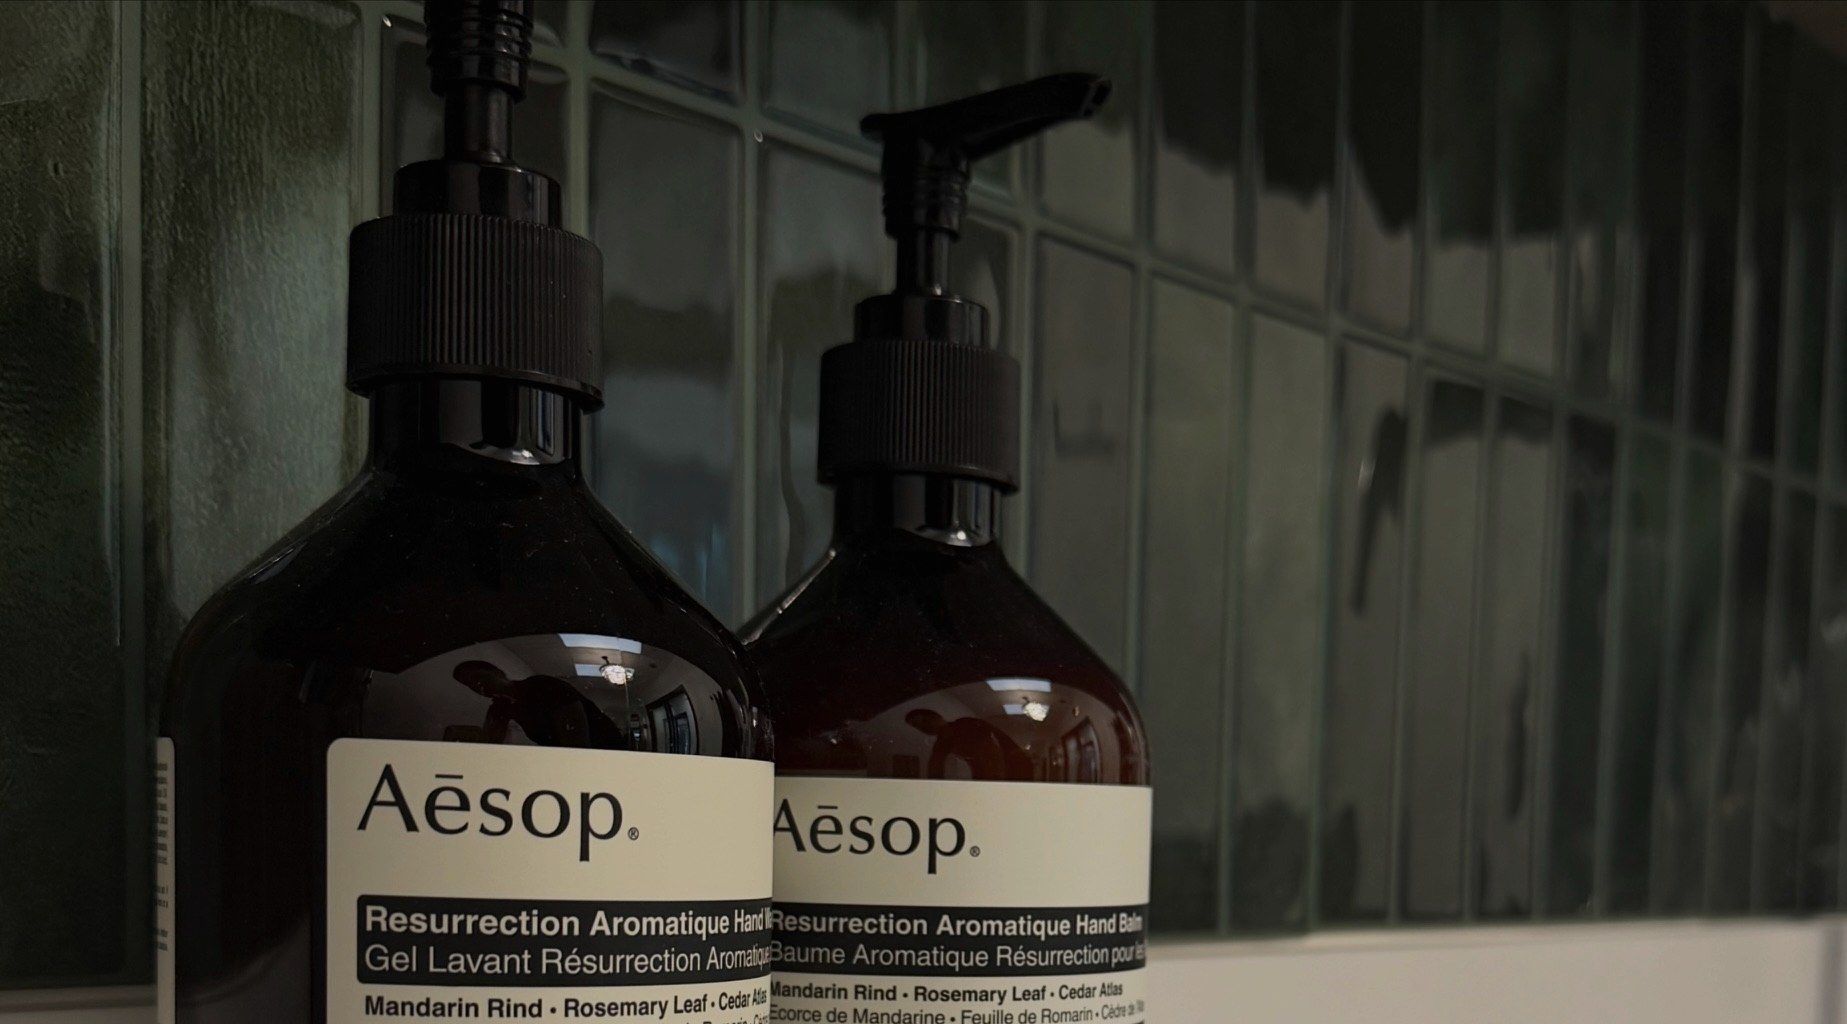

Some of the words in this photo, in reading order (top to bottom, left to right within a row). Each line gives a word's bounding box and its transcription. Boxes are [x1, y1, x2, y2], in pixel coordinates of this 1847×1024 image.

[365, 905, 579, 937] Resurrection
[590, 911, 730, 940] Aromatique
[734, 908, 763, 932] Hand
[772, 911, 927, 936] Resurrection
[936, 913, 1070, 940] Aromatique
[1076, 914, 1116, 935] Hand
[365, 945, 417, 972] Gel
[429, 948, 531, 974] Lavant
[541, 948, 700, 974] Résurrection
[769, 941, 845, 964] Baume
[853, 944, 988, 971] Aromatique
[997, 945, 1109, 967] Résurrection
[1111, 945, 1134, 968] pour
[365, 996, 479, 1017] Mandarin
[488, 999, 542, 1017] Rind
[564, 999, 667, 1020] Rosemary
[674, 994, 707, 1014] Leaf
[719, 991, 750, 1010] Cedar
[854, 984, 896, 1002] Rind
[914, 986, 1008, 1005] Rosemary
[1013, 985, 1045, 1002] Leaf
[1058, 984, 1097, 1000] Cedar
[1100, 982, 1123, 997] Atlas
[828, 1006, 847, 1022] de
[1018, 1006, 1037, 1024] de
[1041, 1005, 1093, 1023] Romarin
